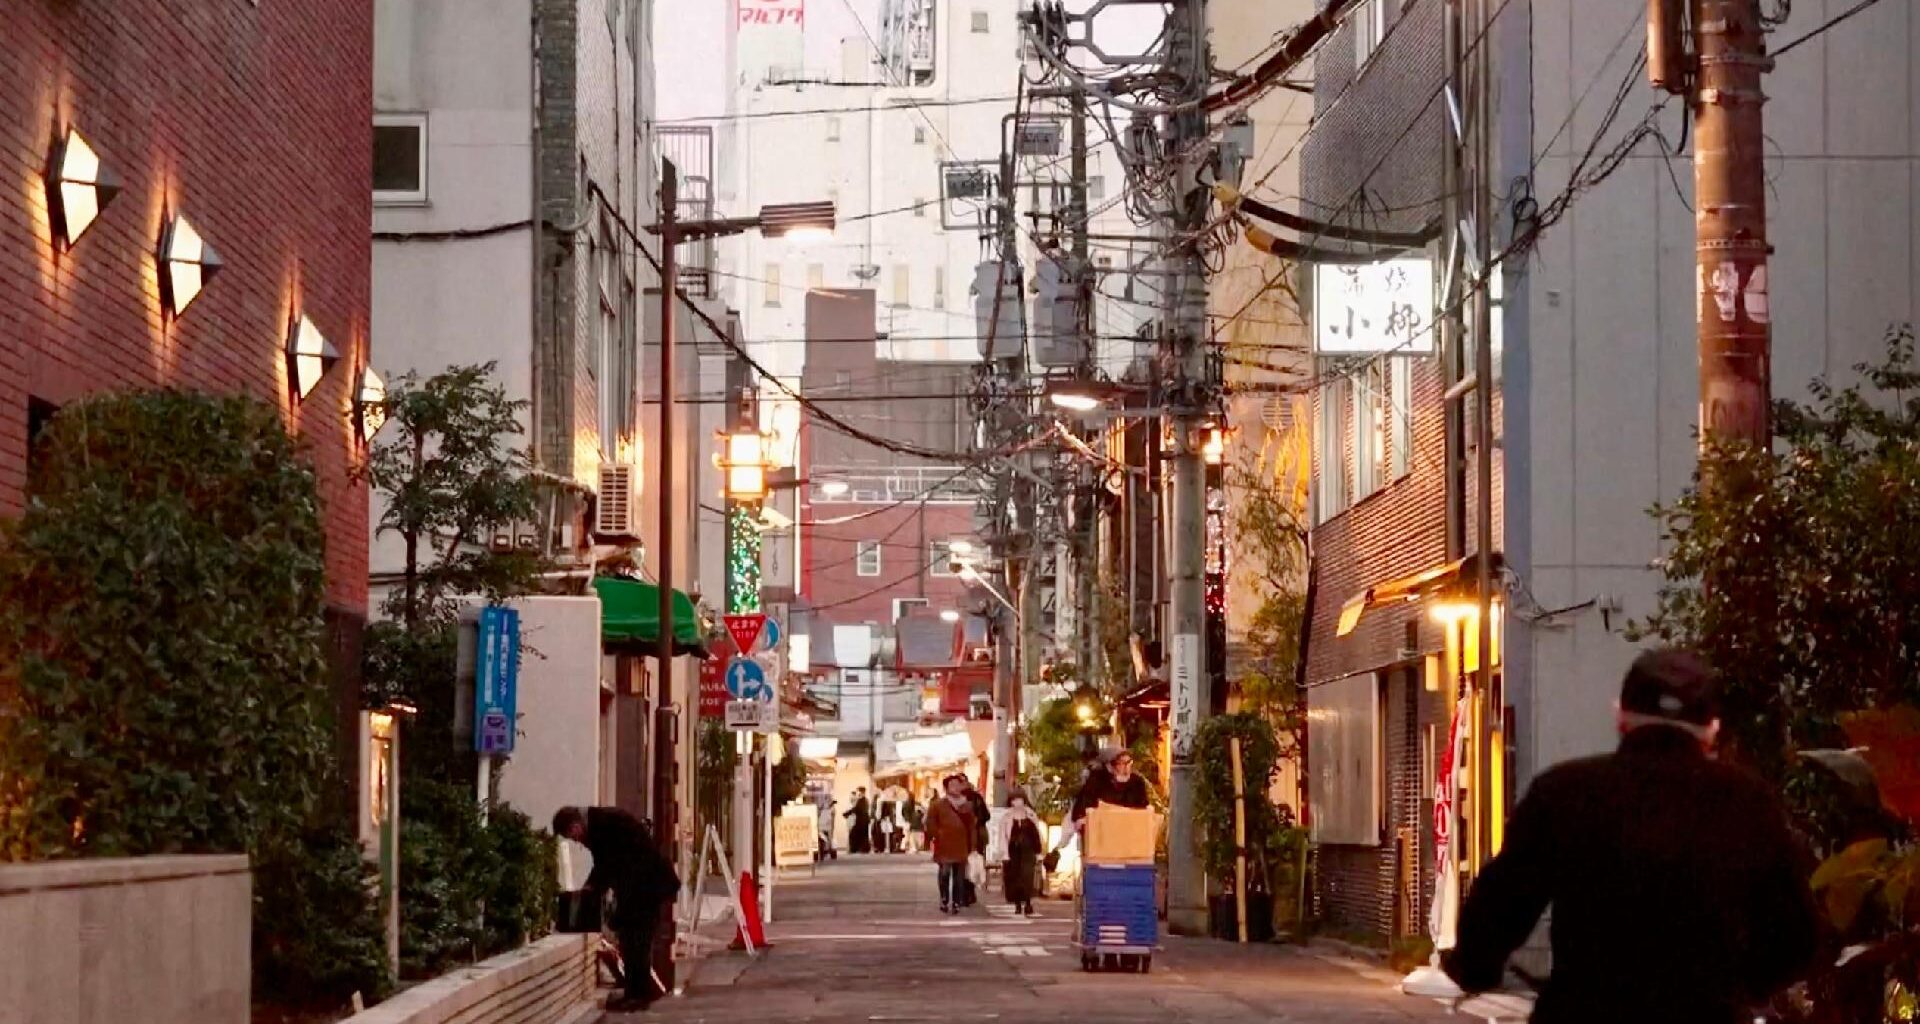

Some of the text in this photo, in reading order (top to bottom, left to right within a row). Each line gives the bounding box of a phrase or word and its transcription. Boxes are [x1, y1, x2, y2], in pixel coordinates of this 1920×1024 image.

[740, 8, 803, 24] マルフク
[1329, 301, 1421, 349] 小柳
[731, 619, 758, 630] 止まれ
[736, 631, 755, 639] STOP
